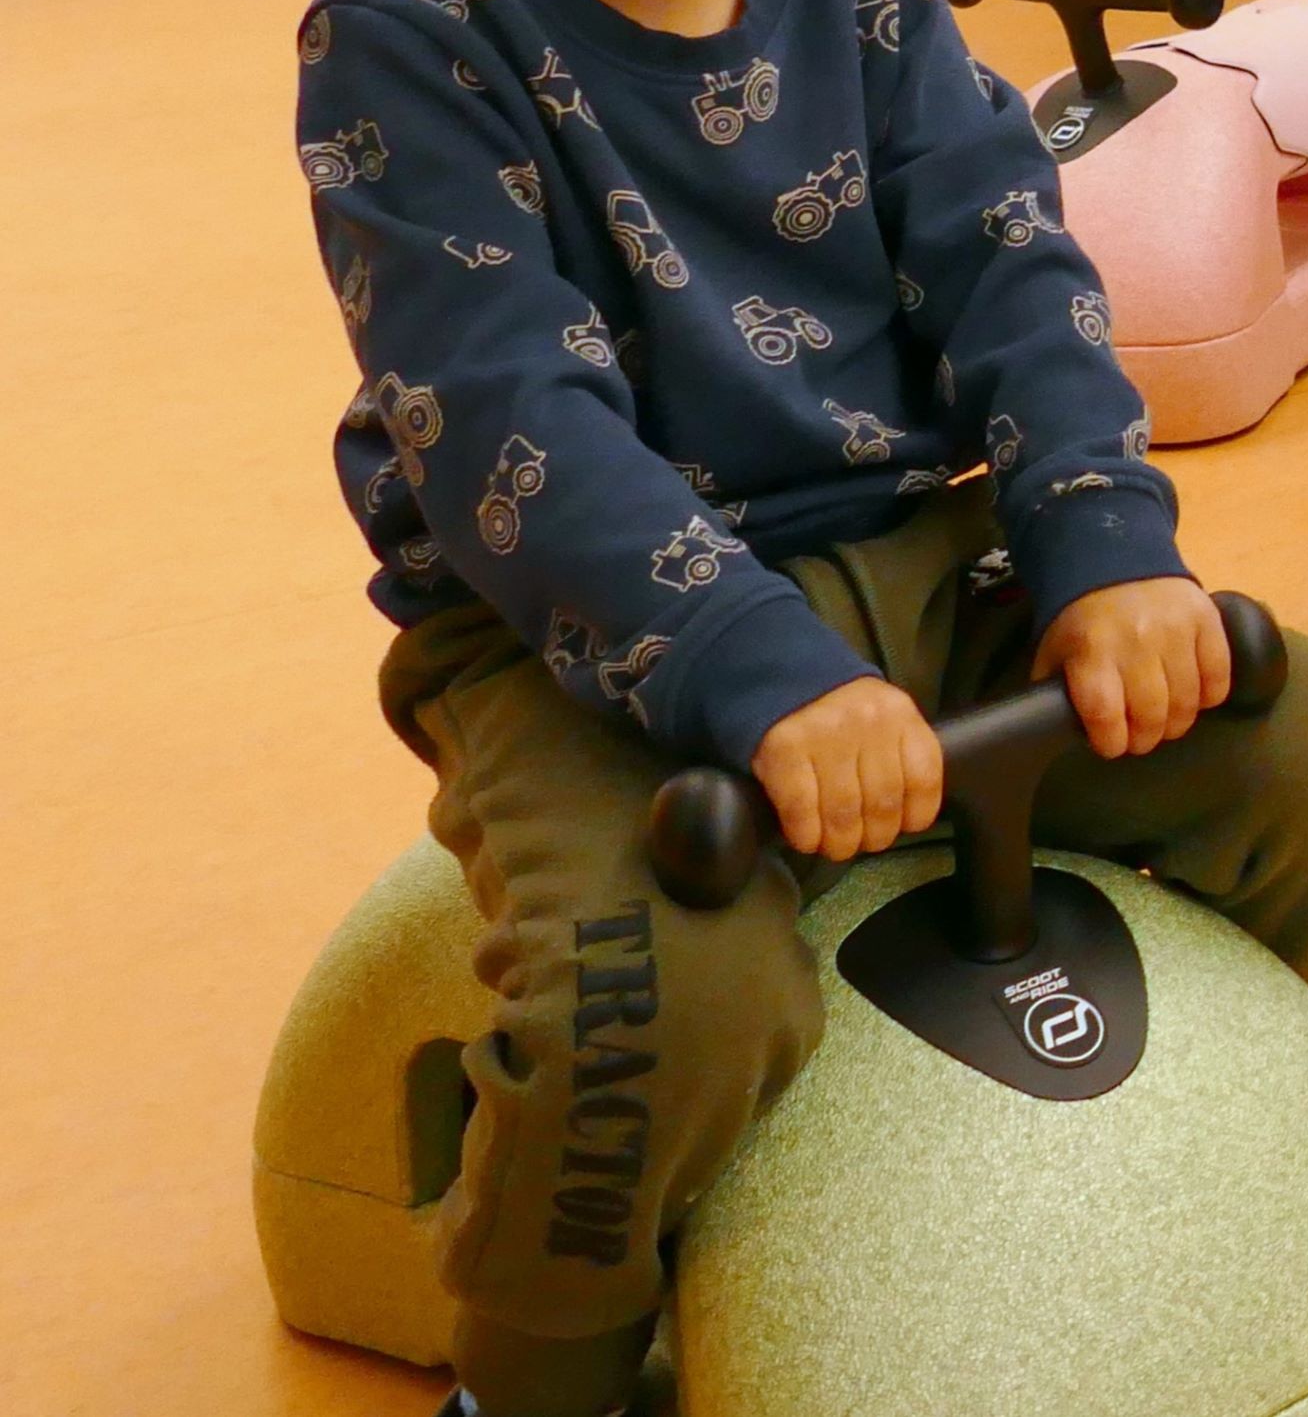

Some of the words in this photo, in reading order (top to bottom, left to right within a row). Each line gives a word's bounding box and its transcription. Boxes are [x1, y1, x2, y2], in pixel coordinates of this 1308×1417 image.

[1004, 967, 1061, 998] SCOOT
[1030, 976, 1069, 1000] RIDE
[545, 898, 660, 1267] TRACTOR
